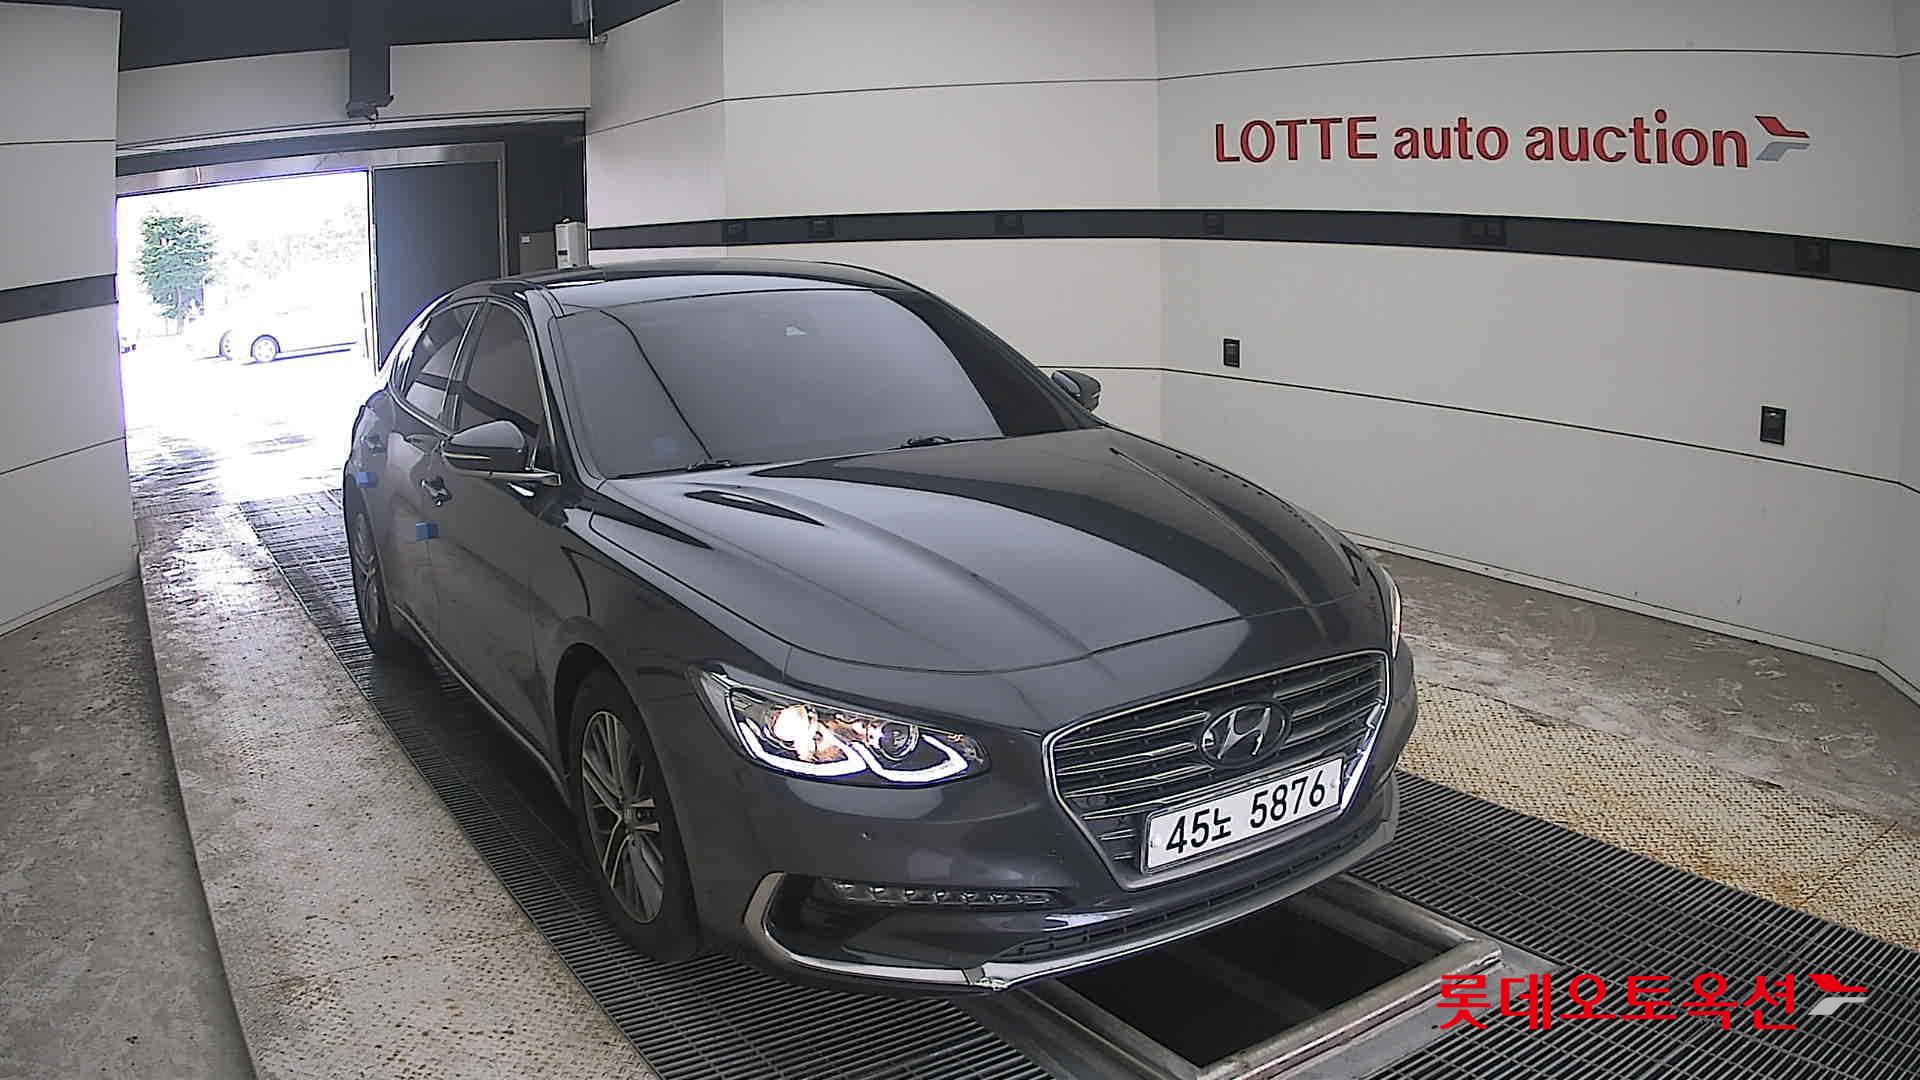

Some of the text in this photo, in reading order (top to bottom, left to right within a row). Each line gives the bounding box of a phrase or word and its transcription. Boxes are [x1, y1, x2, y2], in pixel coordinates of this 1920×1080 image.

[1215, 109, 1750, 168] LOTTE auto auction
[1165, 770, 1326, 855] 45노 5876
